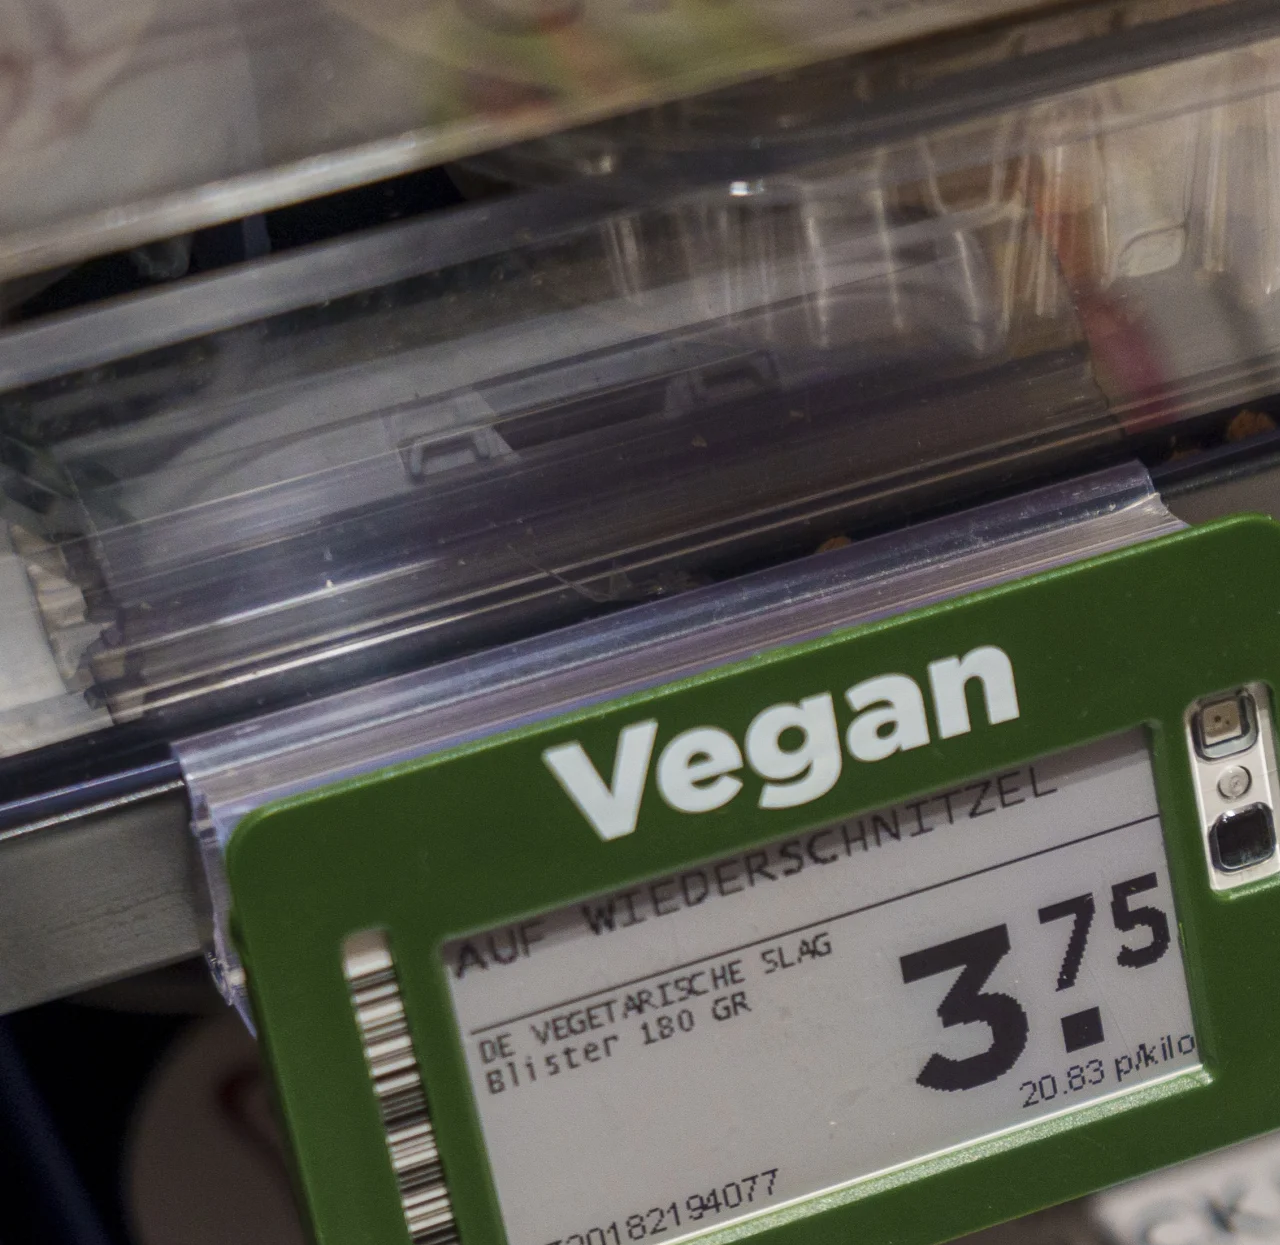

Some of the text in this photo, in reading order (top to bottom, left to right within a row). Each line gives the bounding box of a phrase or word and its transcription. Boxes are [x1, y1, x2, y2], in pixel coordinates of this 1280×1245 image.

[541, 644, 1020, 841] Vegan
[453, 765, 1058, 978] AUF WIEDERSCHNITZEL
[478, 932, 833, 1065] DE VEGETARISCHE SLAG
[486, 990, 752, 1095] Blister 180 GR
[900, 872, 1171, 1092] 3.75
[1018, 1033, 1196, 1109] 20.83 p/kilo
